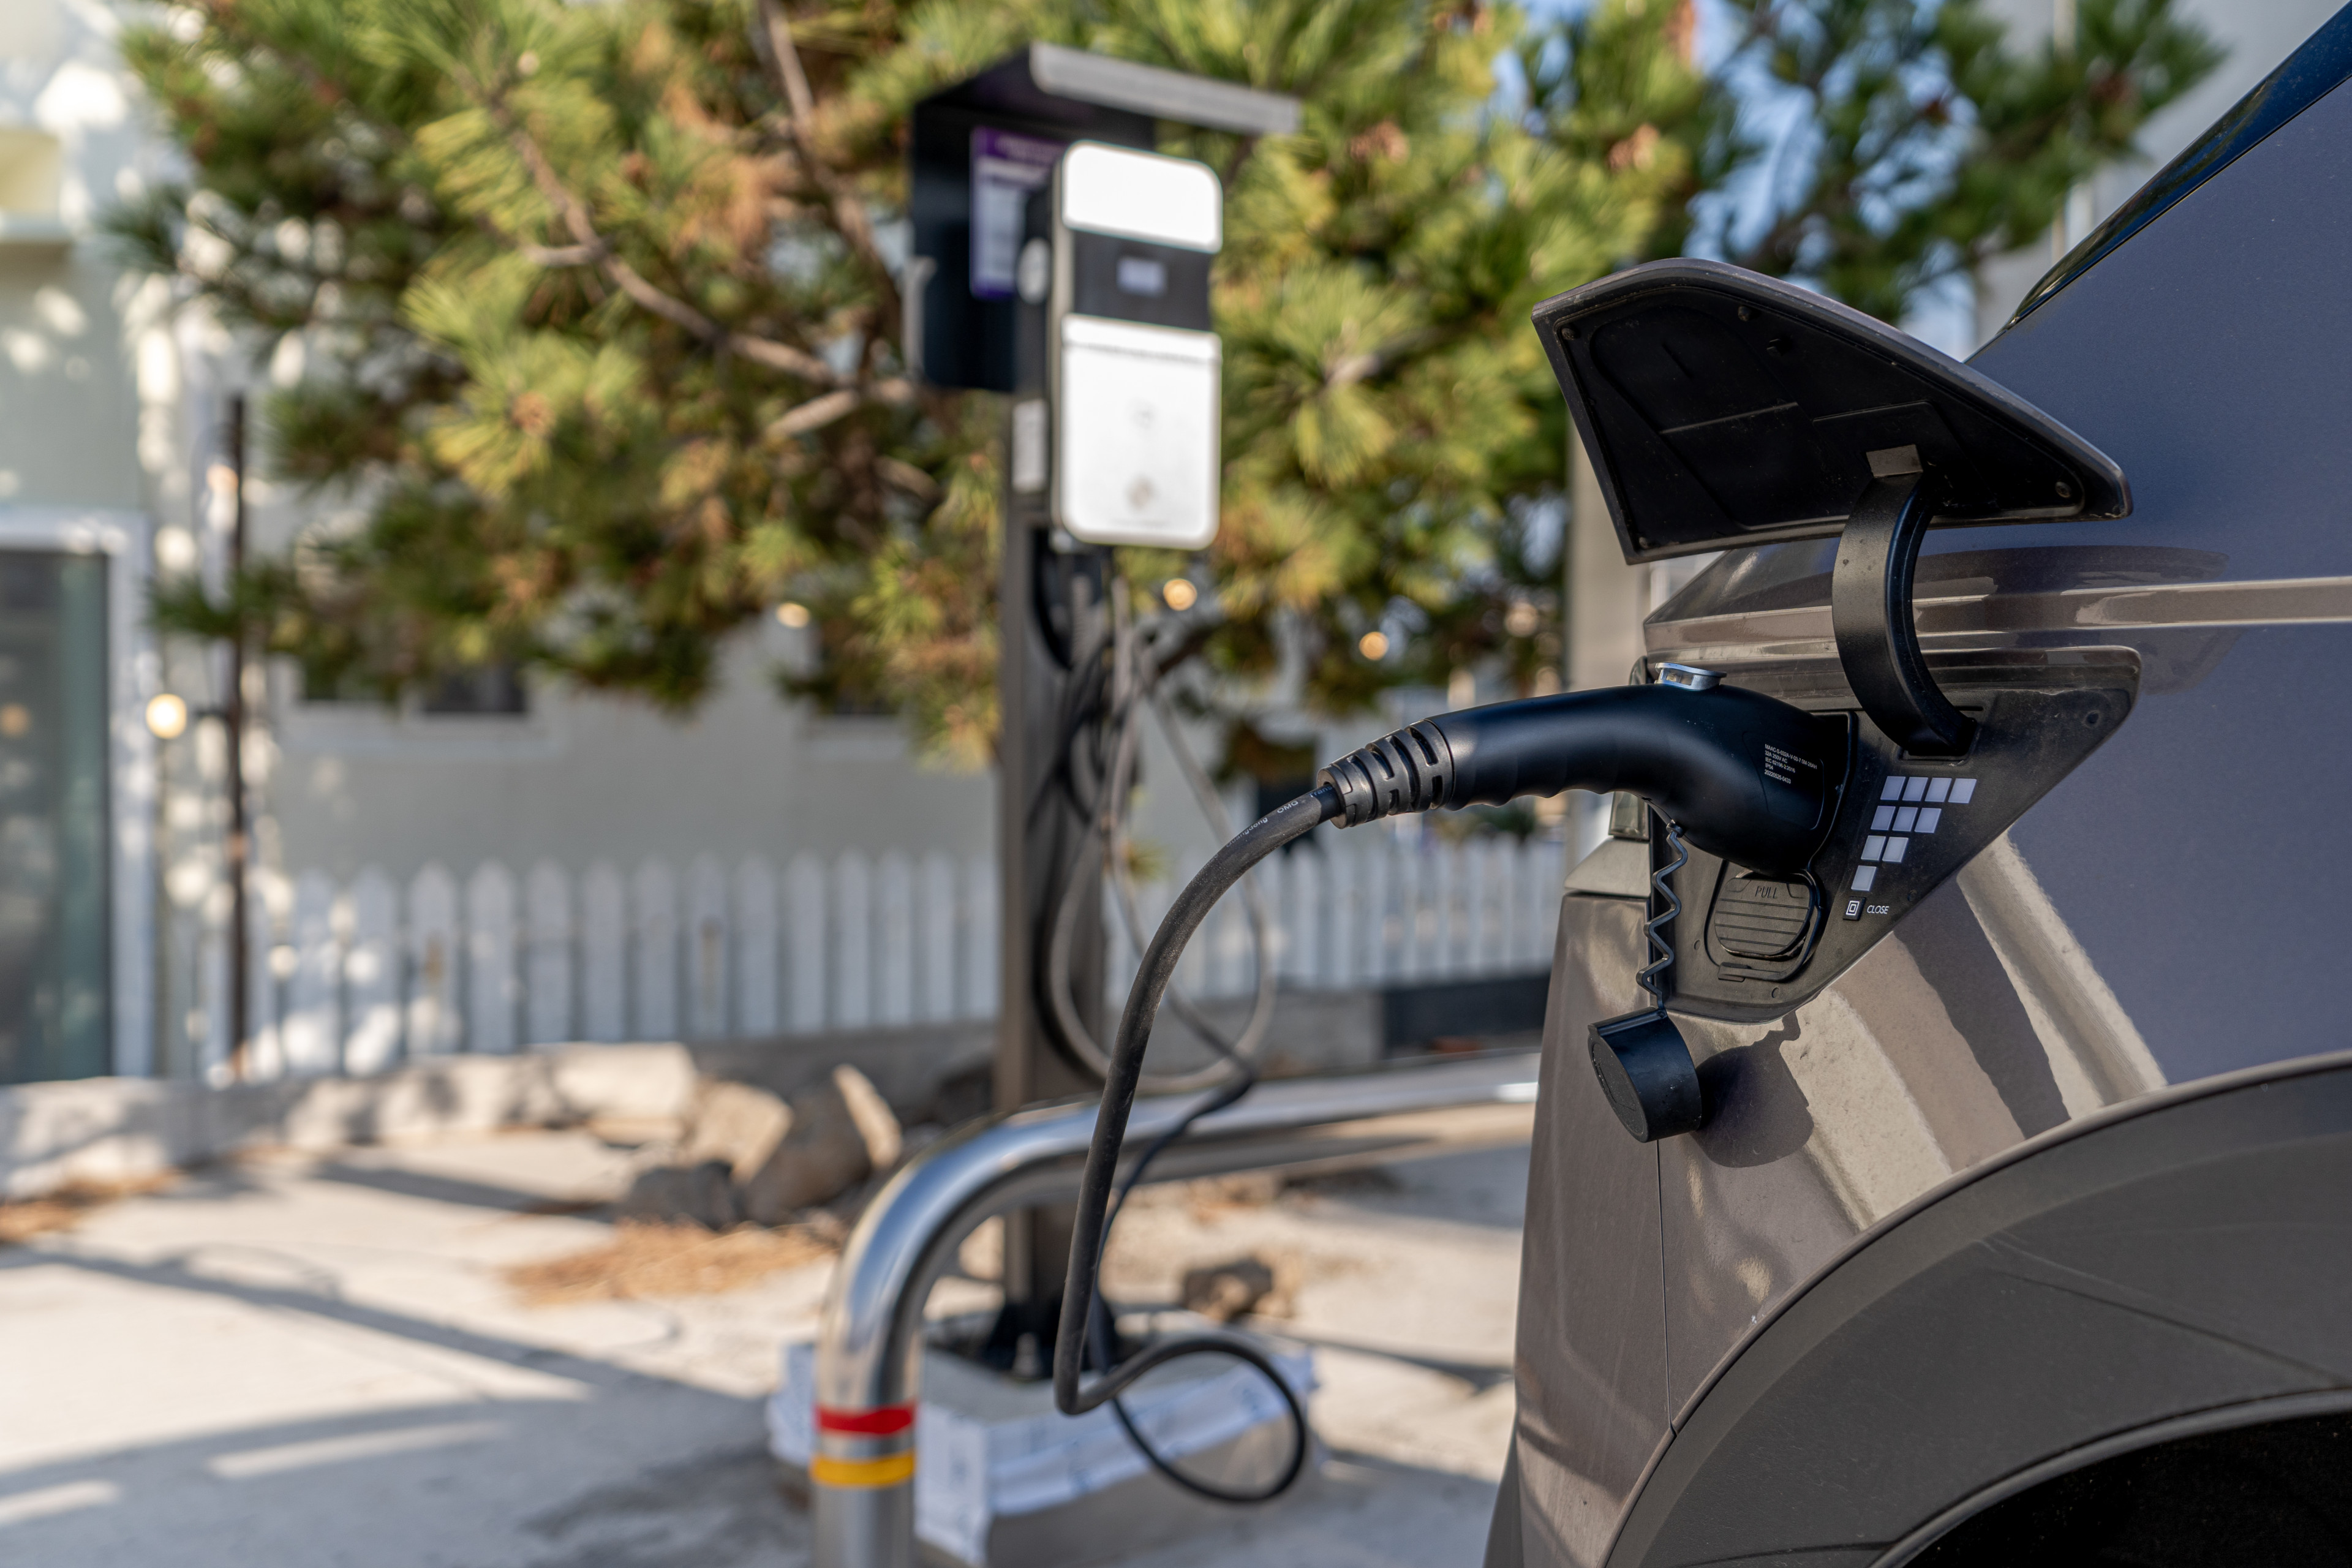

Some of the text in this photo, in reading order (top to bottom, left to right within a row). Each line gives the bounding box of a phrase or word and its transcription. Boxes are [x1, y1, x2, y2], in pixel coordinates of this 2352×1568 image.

[1277, 800, 1298, 813] OMG
[1755, 885, 1778, 899] PULL
[1866, 905, 1890, 914] CLOSE
